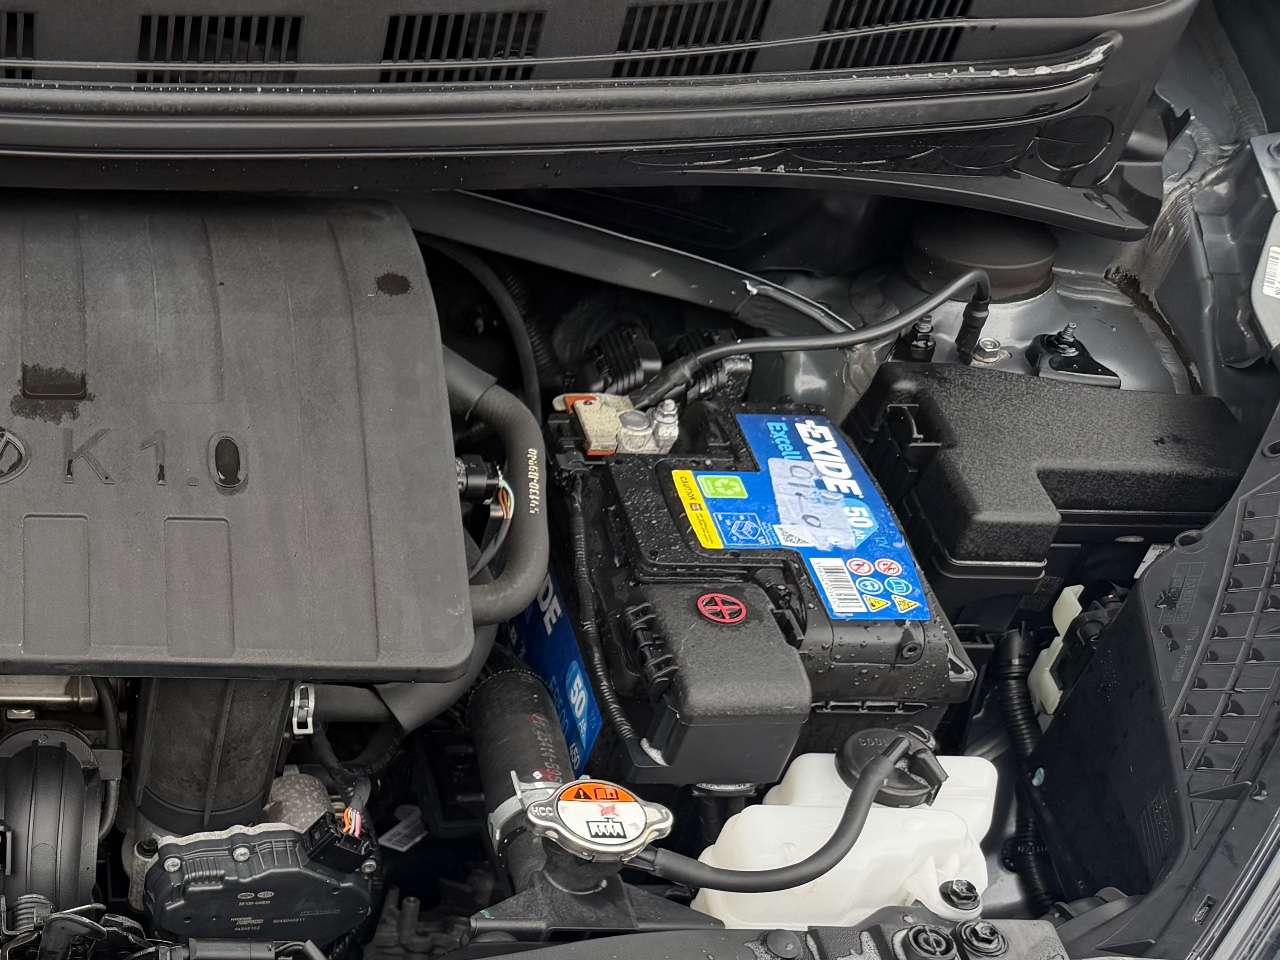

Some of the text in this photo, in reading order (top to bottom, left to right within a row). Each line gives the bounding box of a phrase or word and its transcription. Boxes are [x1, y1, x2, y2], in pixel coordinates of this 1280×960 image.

[63, 428, 250, 488] K 1.0
[795, 421, 863, 498] EXIDE
[844, 506, 870, 528] 50
[531, 806, 554, 817] HCC
